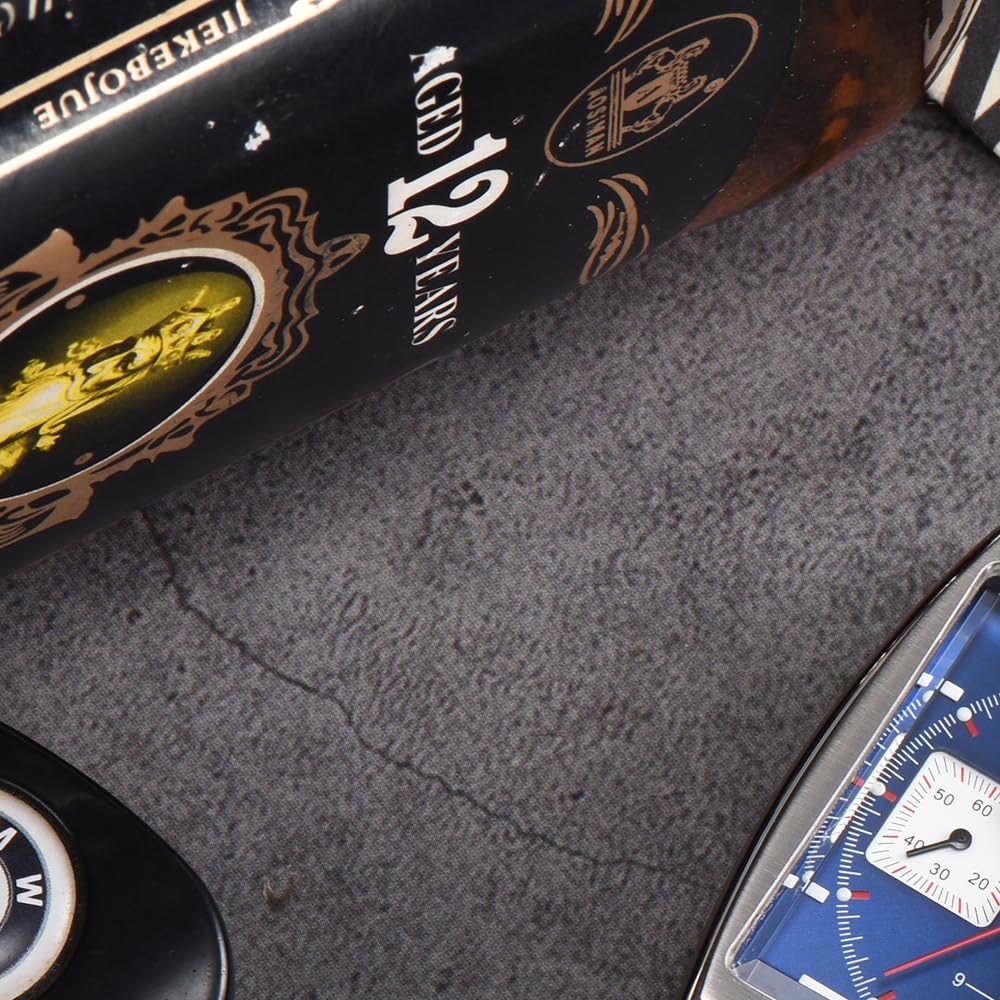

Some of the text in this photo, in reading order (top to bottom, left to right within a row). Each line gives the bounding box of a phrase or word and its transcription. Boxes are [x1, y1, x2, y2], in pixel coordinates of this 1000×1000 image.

[33, 0, 251, 130] JIEKEBOJUE
[384, 45, 509, 345] AGED 12 YEARS
[933, 788, 955, 806] 50
[972, 799, 993, 817] 60
[904, 835, 925, 851] 40
[929, 863, 951, 880] 30
[968, 873, 990, 890] 20
[952, 972, 966, 987] 9
